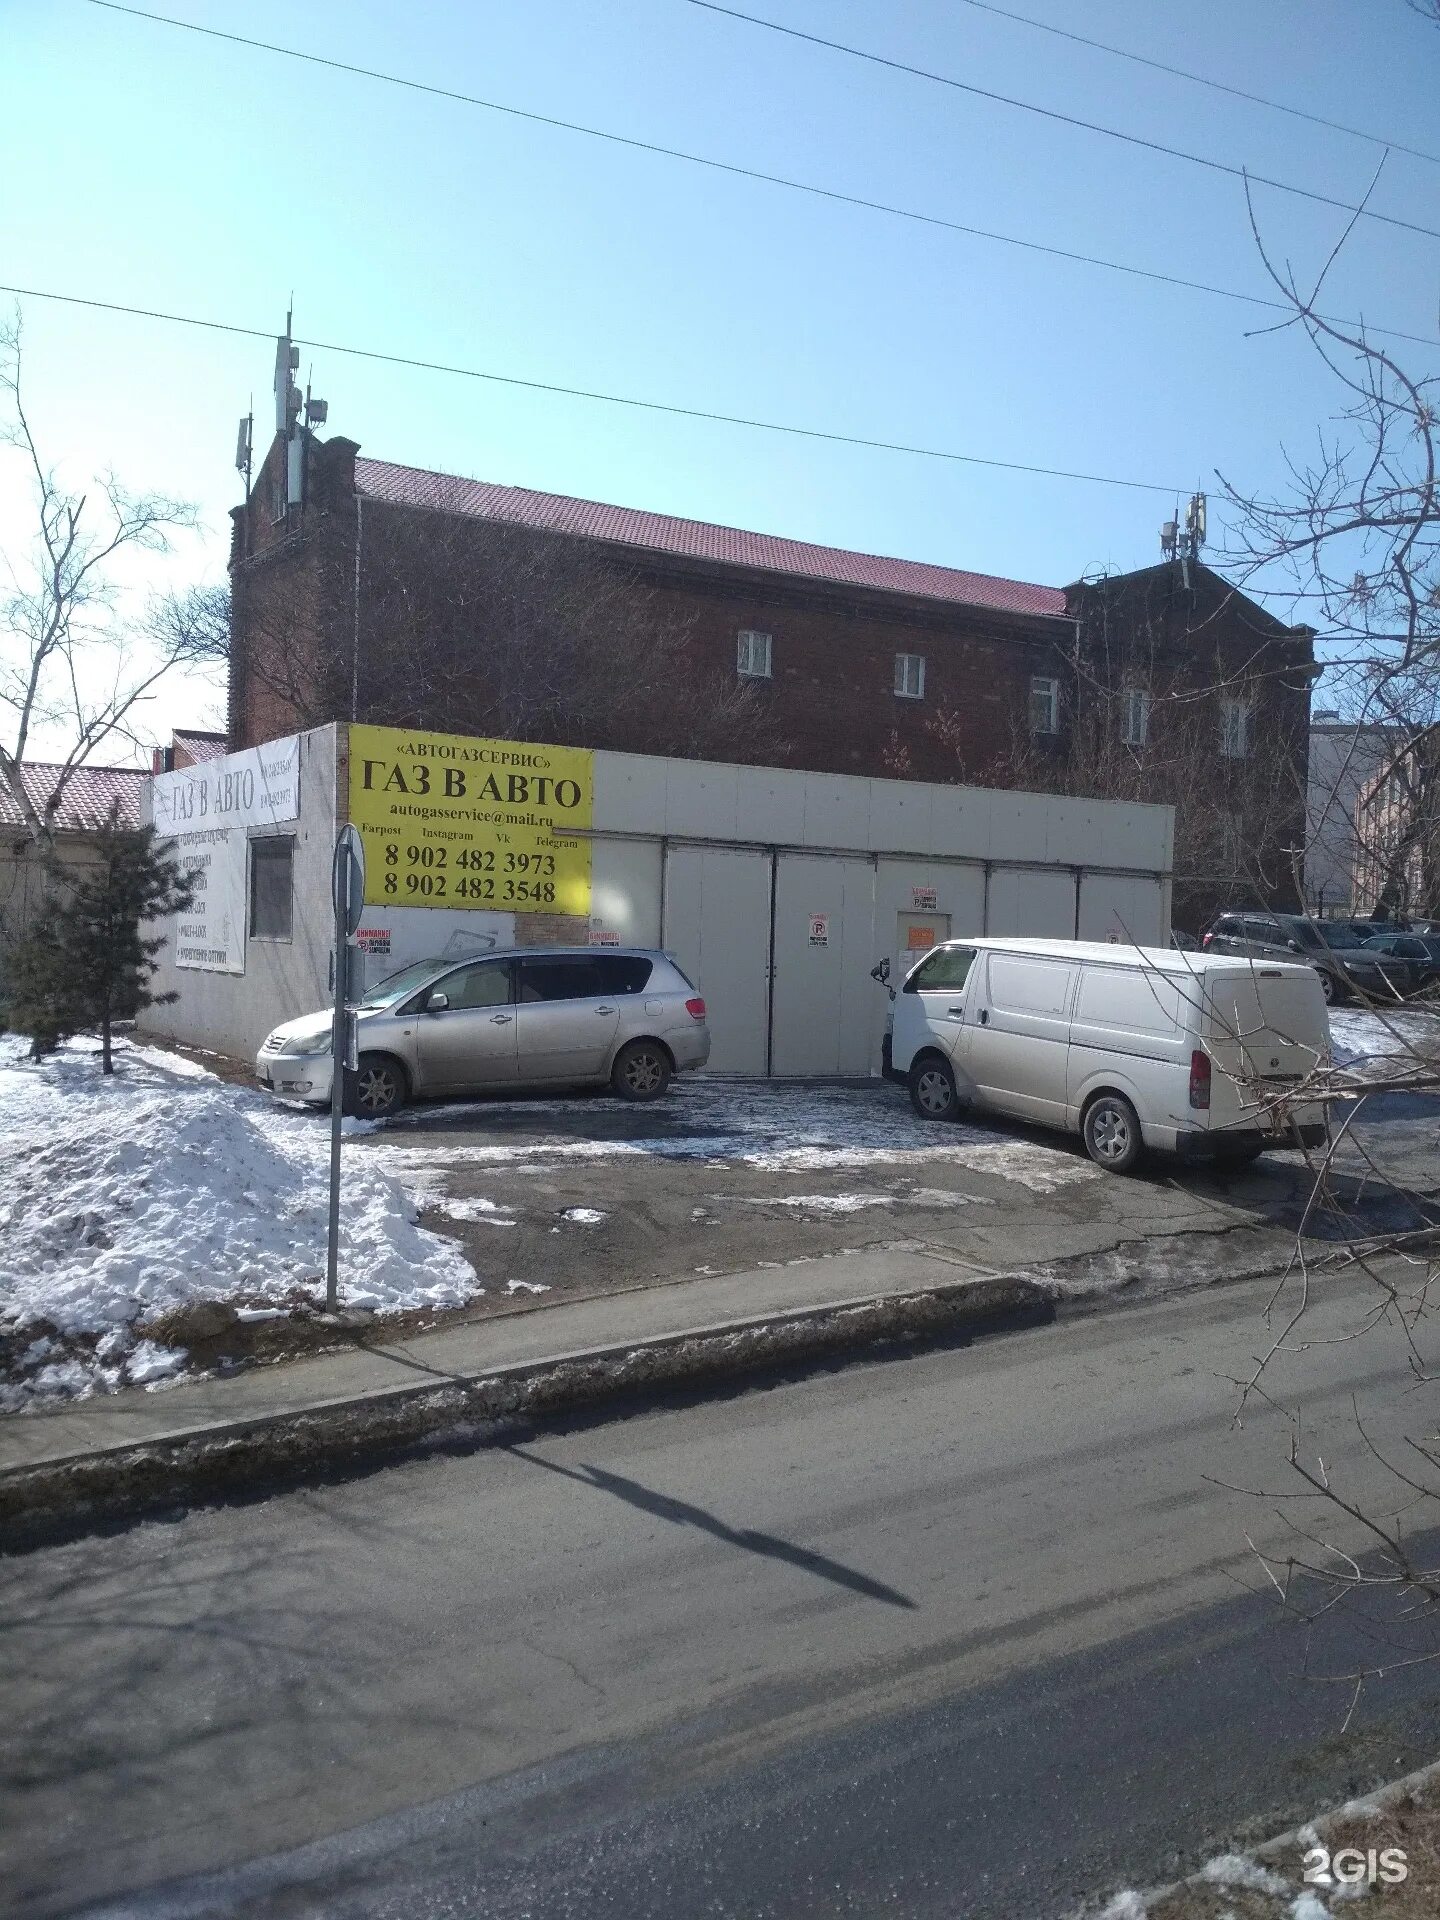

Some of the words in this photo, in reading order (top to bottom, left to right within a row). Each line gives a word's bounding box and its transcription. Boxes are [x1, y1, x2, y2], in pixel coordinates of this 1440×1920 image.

[397, 743, 551, 769] «АВТОГАЗСЕРВИС»
[172, 782, 194, 821] ГАЗ
[200, 779, 208, 817] В
[214, 768, 255, 814] АВТО
[362, 760, 430, 795] ГАЗ
[442, 768, 467, 798] В
[477, 772, 581, 808] АВТО
[389, 804, 553, 828] autogasservice@mail.ru
[361, 823, 401, 837] Farpost
[422, 827, 474, 842] Instagram
[496, 834, 511, 844] Vk
[536, 836, 578, 850] Telegram
[385, 844, 399, 866] 8
[406, 845, 447, 869] 902
[455, 849, 496, 872] 482
[503, 853, 556, 877] 3973
[384, 872, 398, 894] 8
[405, 875, 447, 897] 902
[454, 877, 496, 900] 482
[502, 880, 556, 903] 3548
